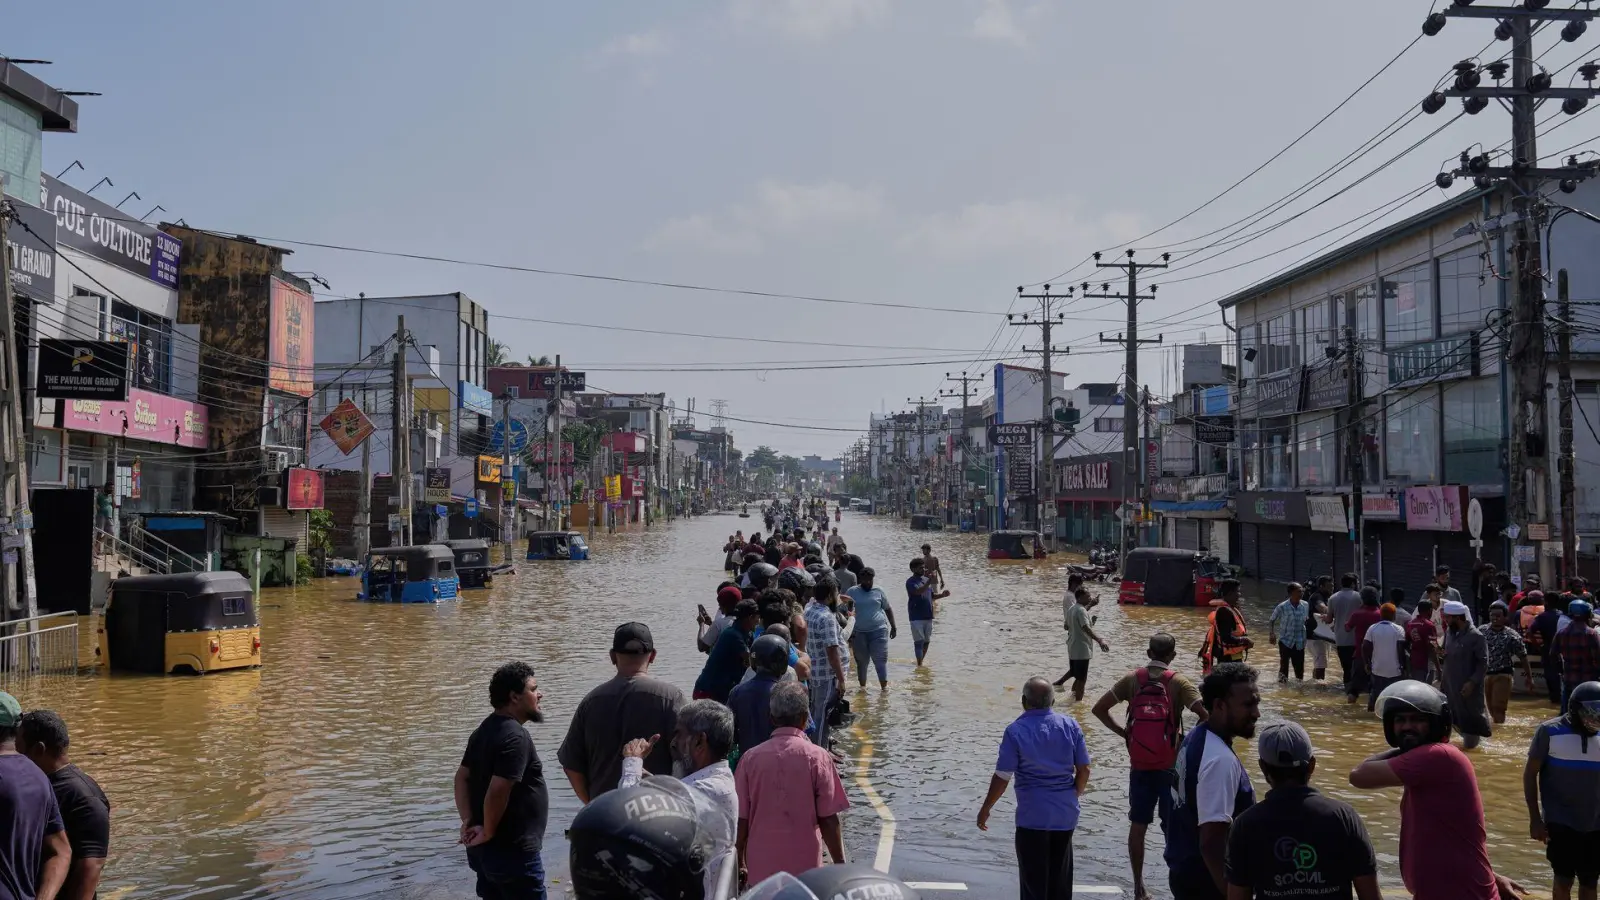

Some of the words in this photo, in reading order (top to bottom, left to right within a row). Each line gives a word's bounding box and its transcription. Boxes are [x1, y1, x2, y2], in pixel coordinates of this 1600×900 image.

[53, 195, 86, 237] CUE
[90, 212, 152, 266] CULTURE
[21, 245, 52, 278] GRAND
[1394, 339, 1466, 381] MADAME
[44, 375, 59, 384] THE
[60, 375, 93, 386] PAVILION
[95, 377, 120, 387] GRAND
[996, 426, 1028, 434] MEGA
[1062, 463, 1084, 490] MEGA
[1085, 461, 1108, 489] SALE
[427, 489, 449, 498] HOUSE
[1274, 871, 1326, 886] SOCIAL
